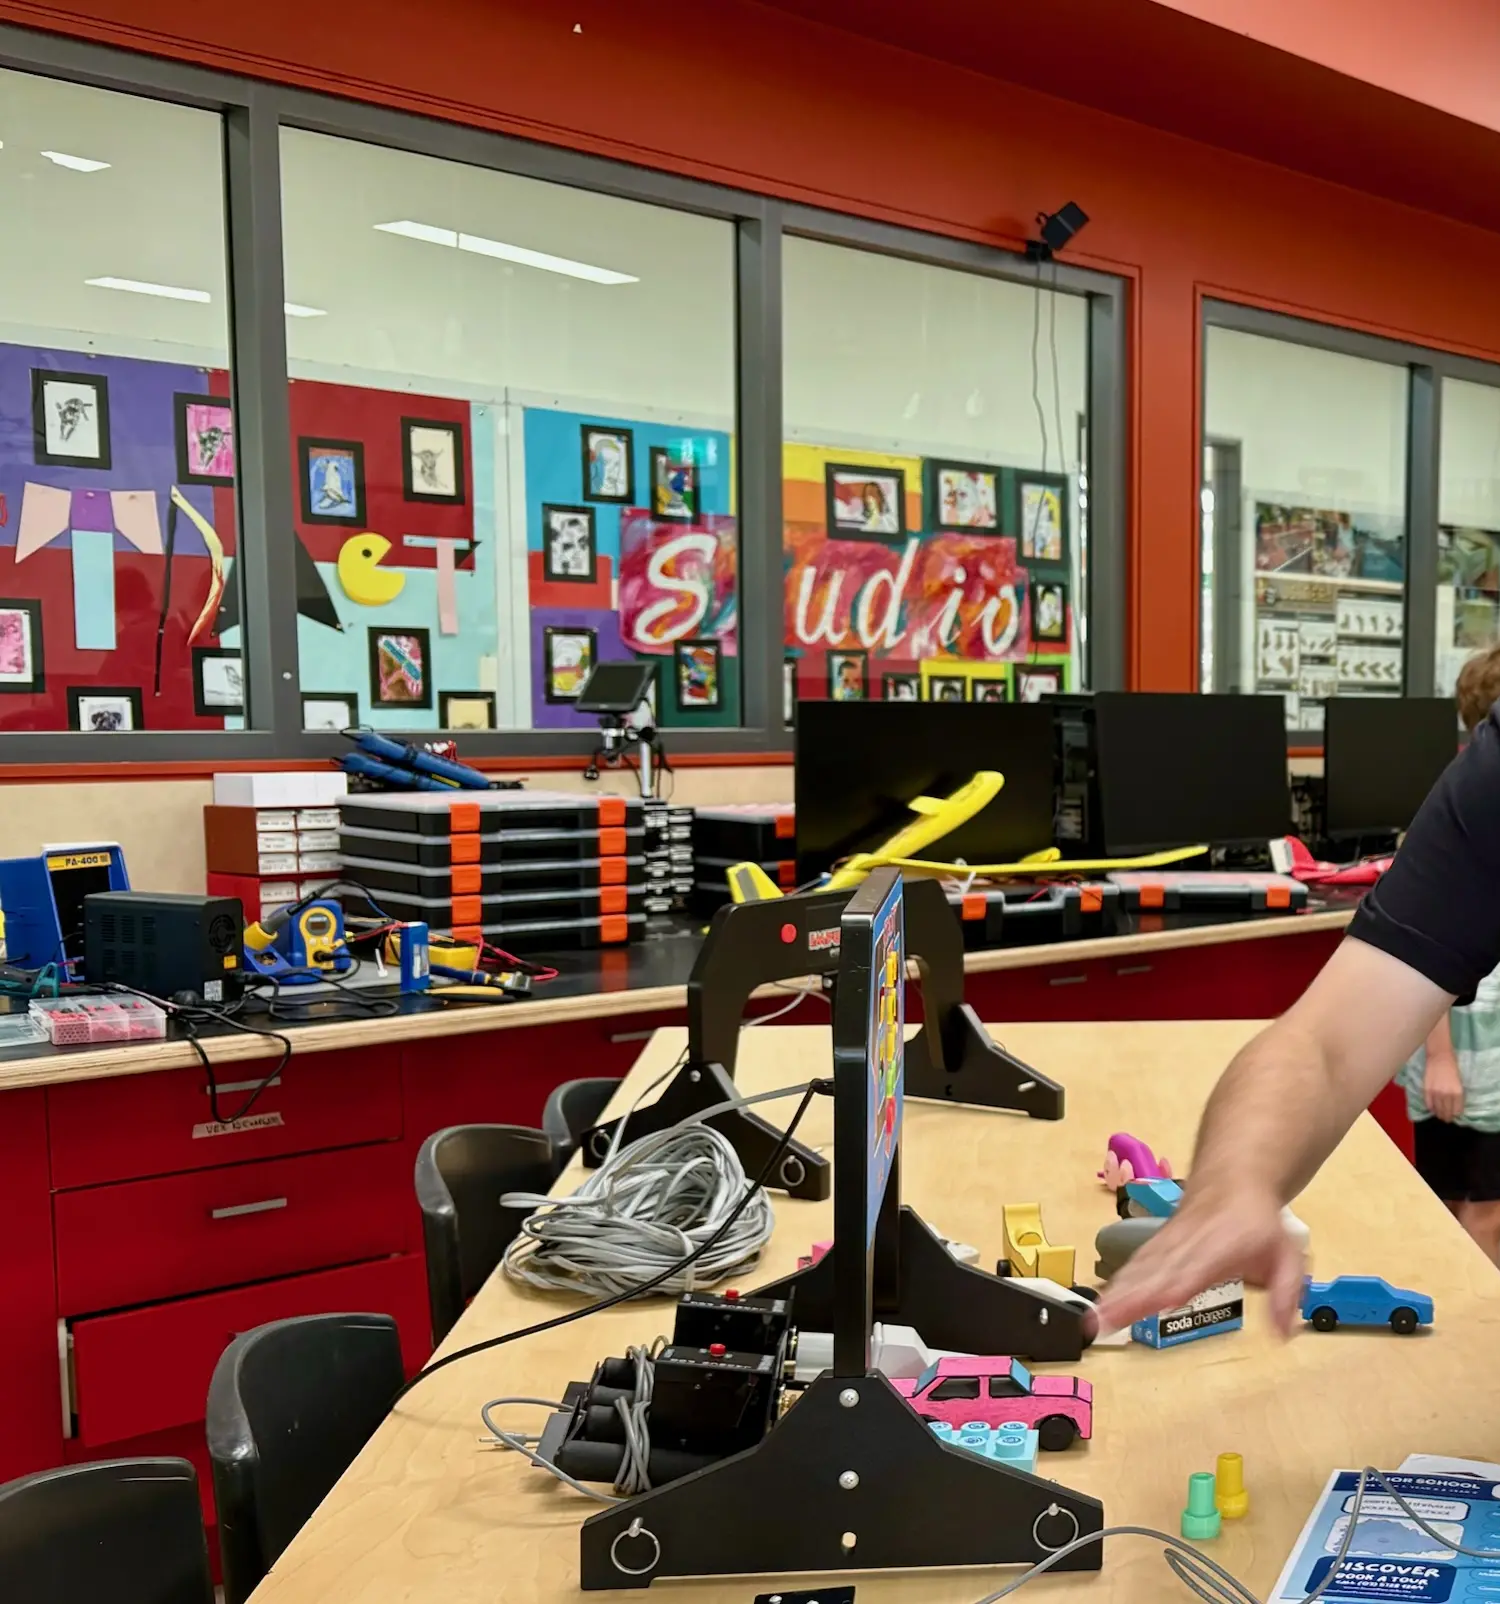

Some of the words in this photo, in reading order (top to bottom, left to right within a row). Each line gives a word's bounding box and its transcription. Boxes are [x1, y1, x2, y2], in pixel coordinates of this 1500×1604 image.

[634, 533, 1020, 655] Sudio
[1166, 1315, 1193, 1333] soda
[1194, 1306, 1232, 1326] chargers
[1418, 1477, 1481, 1490] SCHOOL
[1335, 1572, 1375, 1581] BOOK
[1391, 1576, 1428, 1585] TOUR
